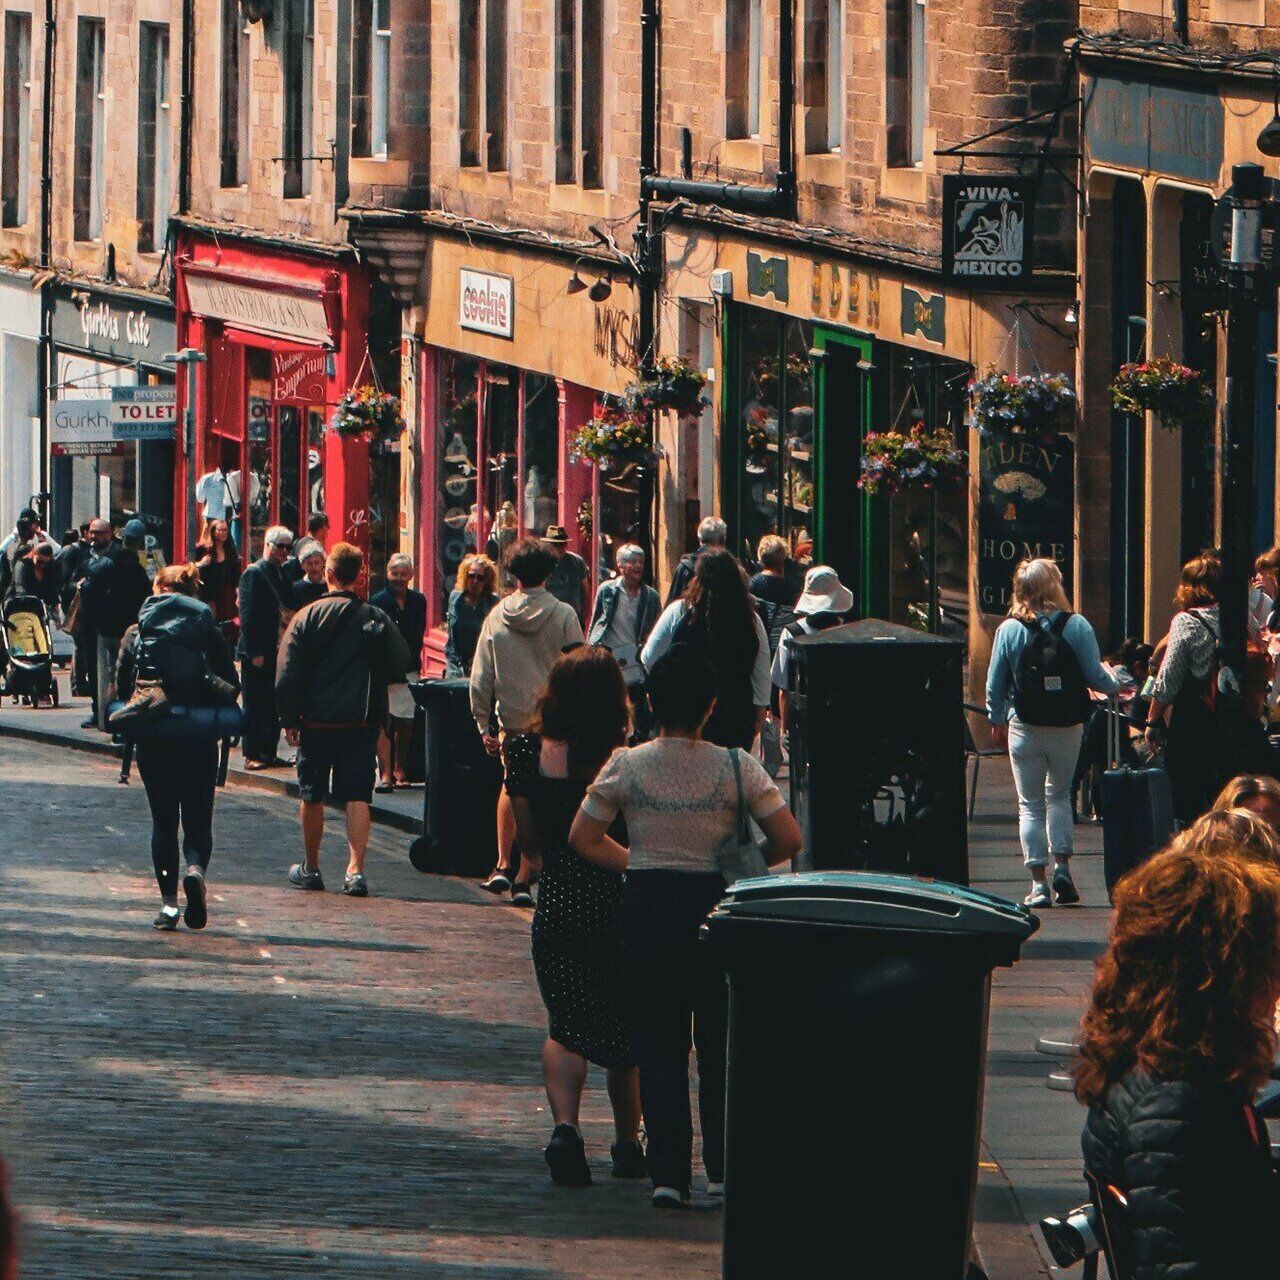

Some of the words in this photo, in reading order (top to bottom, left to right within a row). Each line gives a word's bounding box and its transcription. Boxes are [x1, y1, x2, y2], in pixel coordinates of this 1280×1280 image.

[966, 187, 1013, 200] VIVA
[952, 261, 1022, 276] MEXICO
[55, 409, 112, 429] Gurkh
[120, 405, 142, 418] TO
[145, 405, 175, 418] LET
[983, 539, 1066, 563] HOME
